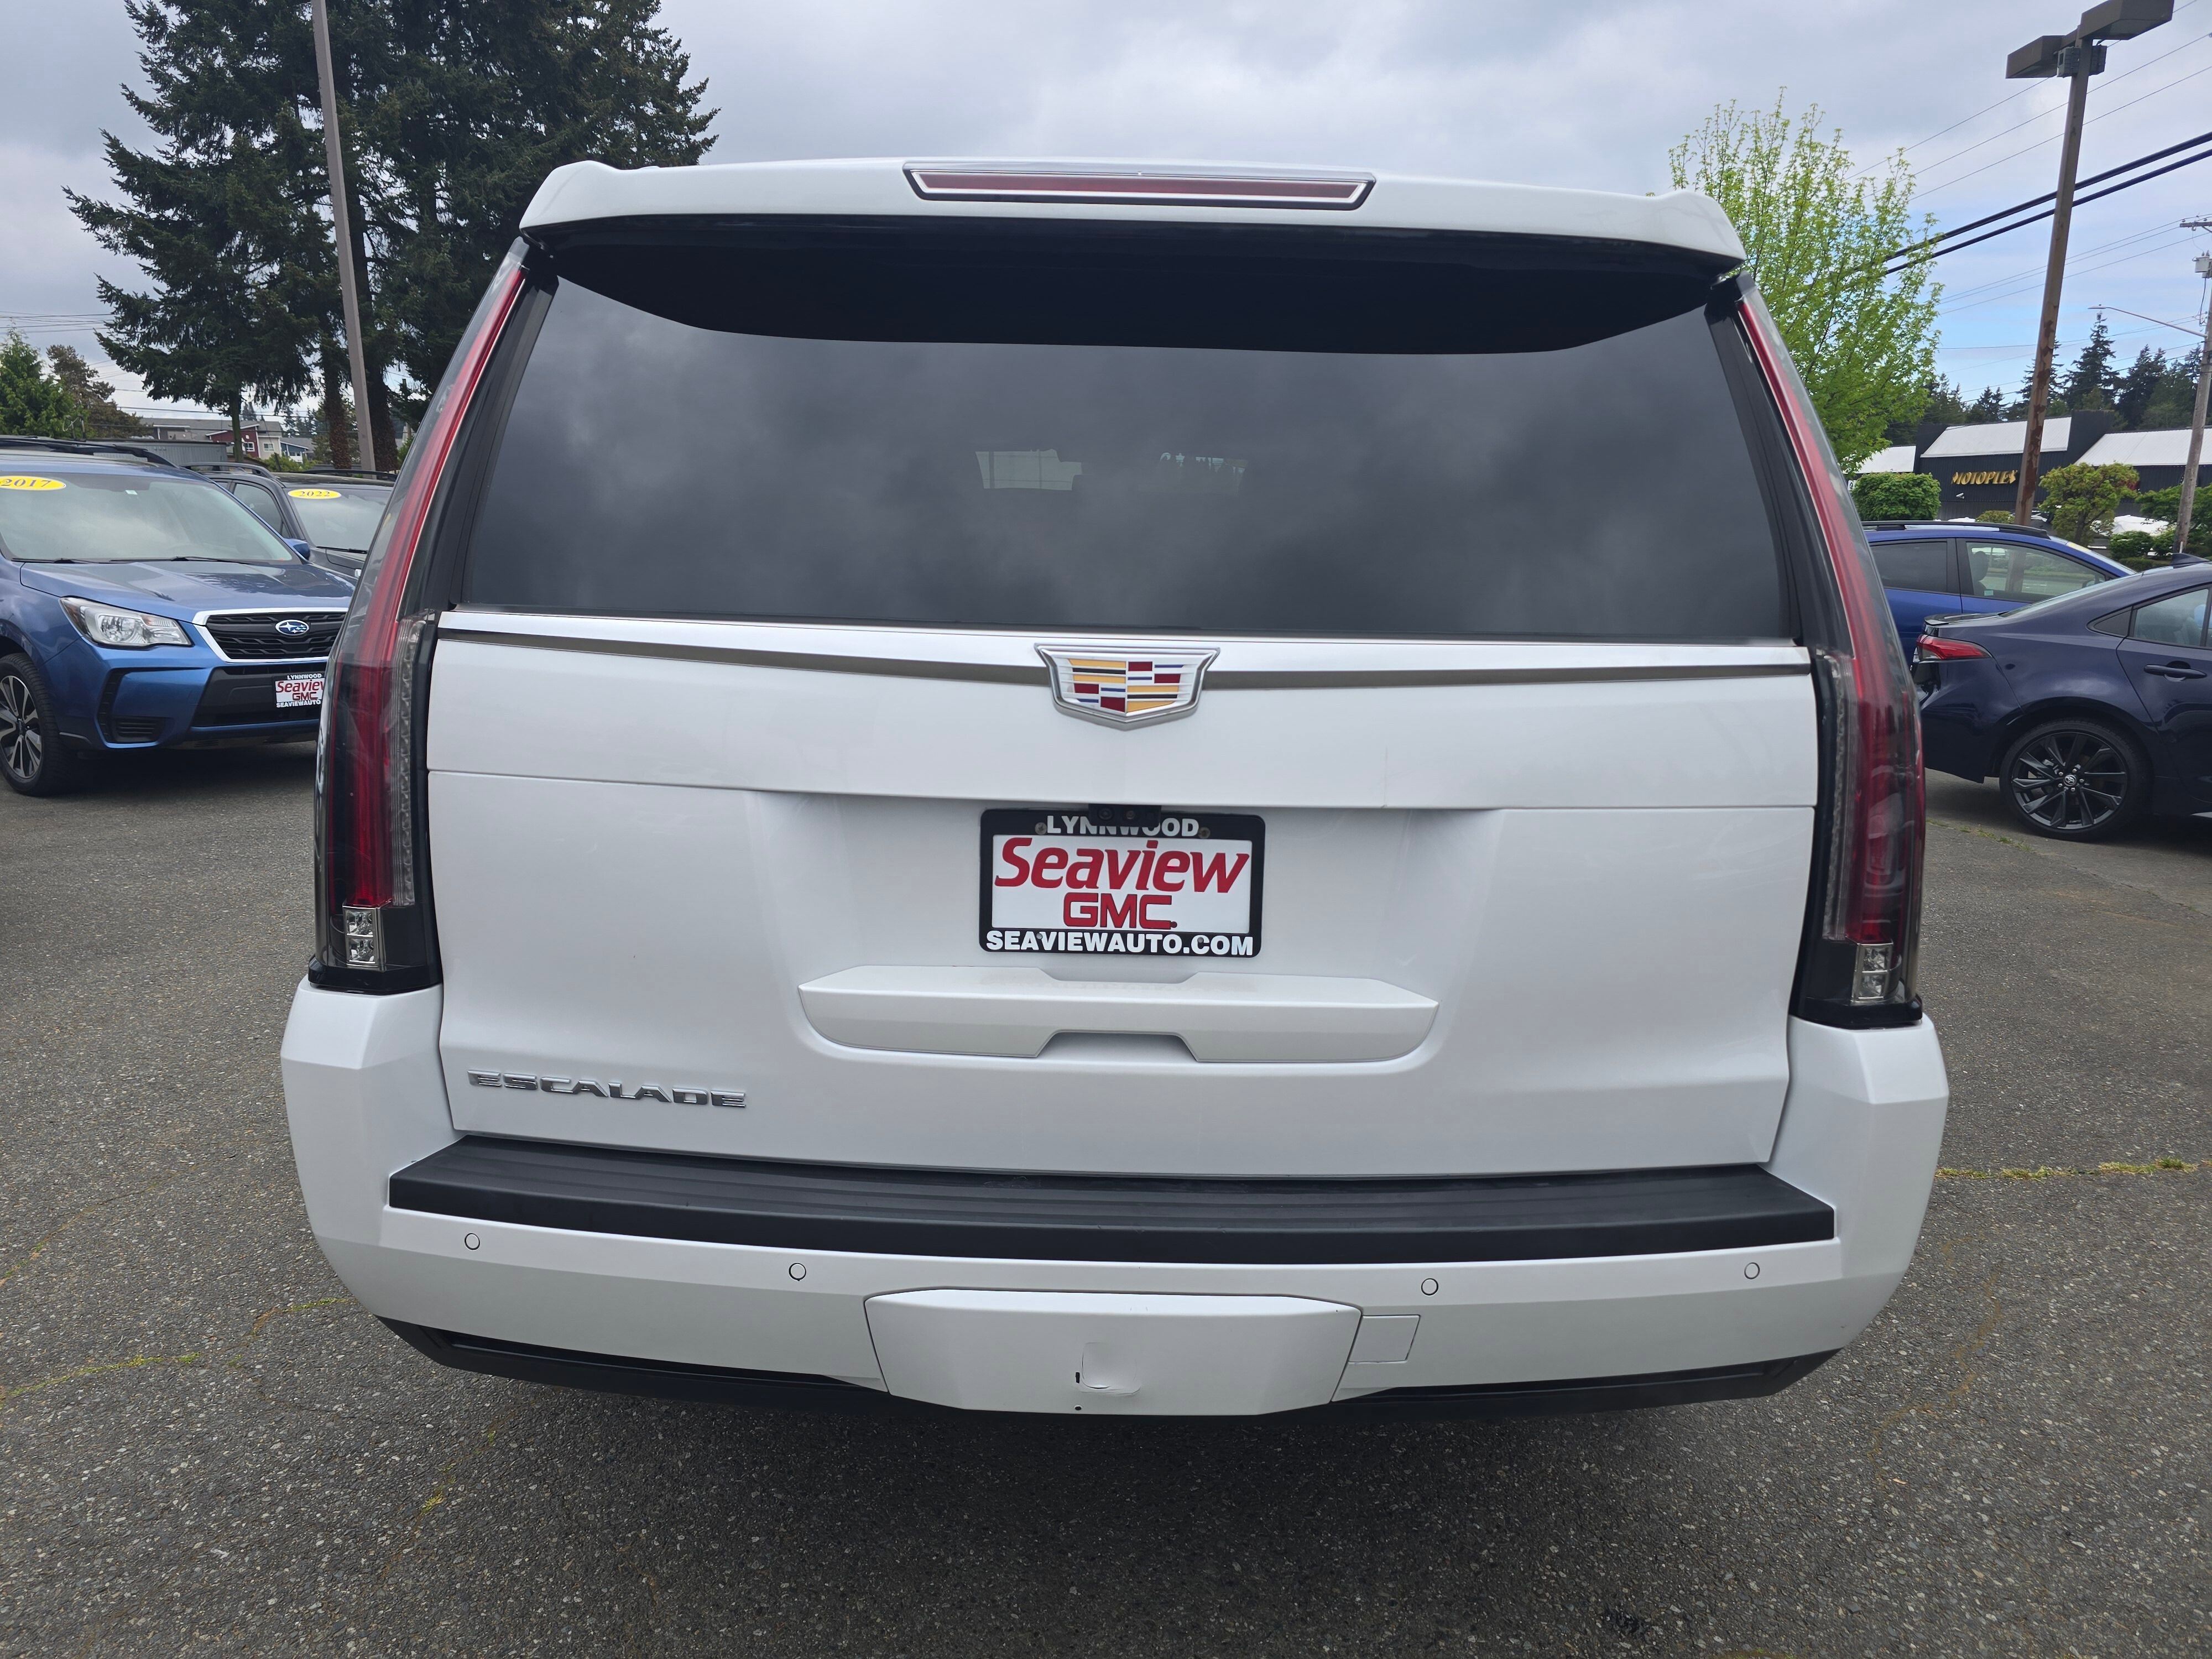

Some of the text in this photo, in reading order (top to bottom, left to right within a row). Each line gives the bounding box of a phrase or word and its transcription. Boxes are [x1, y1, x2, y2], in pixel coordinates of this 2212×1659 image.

[0, 479, 51, 487] 2017
[1951, 469, 2018, 484] MOTOPLEX
[292, 691, 318, 701] GMC
[995, 837, 1250, 893] Seaview
[1063, 892, 1178, 930] GMC
[986, 930, 1254, 956] SEAVIEWAUTO.COM
[467, 1069, 747, 1108] ESCALADE
